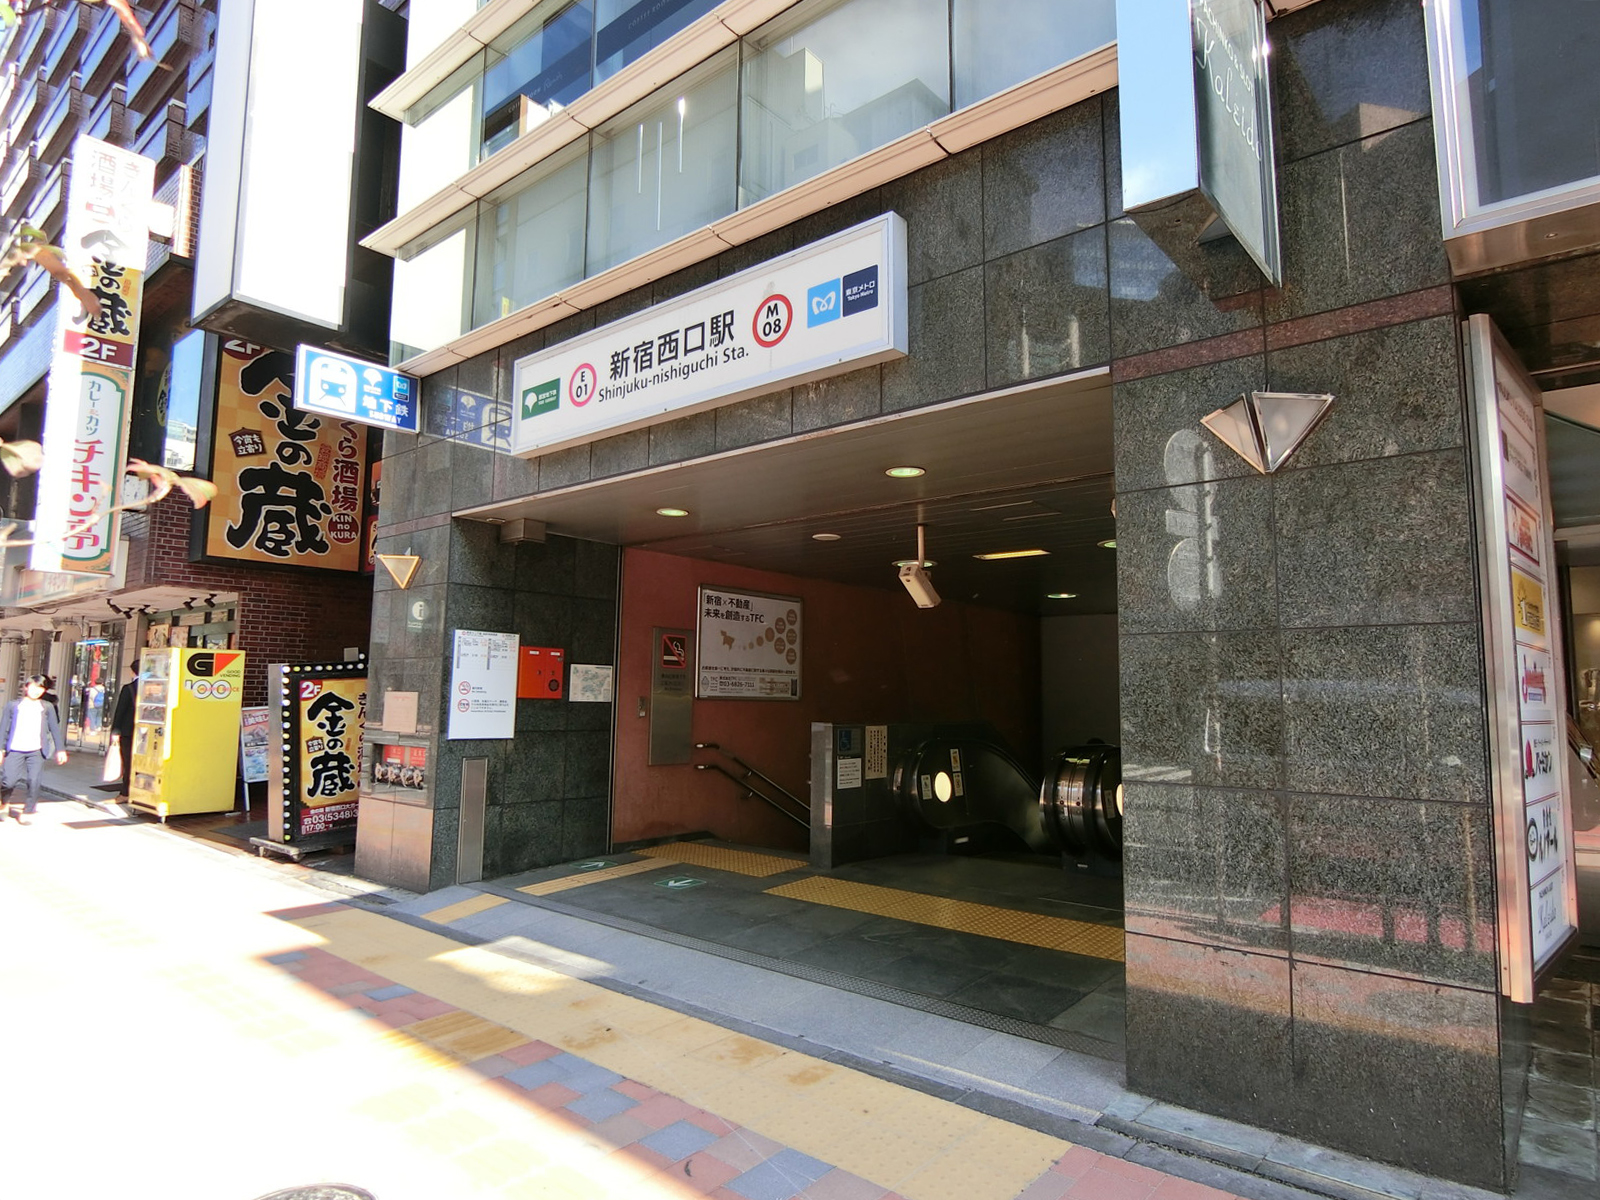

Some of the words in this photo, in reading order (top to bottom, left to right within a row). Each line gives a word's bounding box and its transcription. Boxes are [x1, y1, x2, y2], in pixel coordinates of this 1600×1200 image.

[845, 280, 875, 296] 東京メトロ
[846, 293, 860, 301] Tokyo
[766, 303, 779, 319] M
[762, 319, 782, 337] 08
[80, 337, 118, 361] 2F
[609, 310, 735, 381] 新宿西口駅
[581, 371, 586, 382] E
[598, 350, 719, 402] Shinjuku-nishiguchi
[722, 346, 750, 364] Sta.
[576, 384, 588, 398] 01
[362, 394, 409, 418] 地下鉄
[226, 350, 331, 557] 金の蔵
[63, 438, 104, 550] チキン亭
[332, 514, 353, 523] KIN
[336, 522, 351, 530] no
[330, 530, 357, 539] KURA
[301, 681, 322, 698] 2F
[307, 691, 356, 798] 金の蔵
